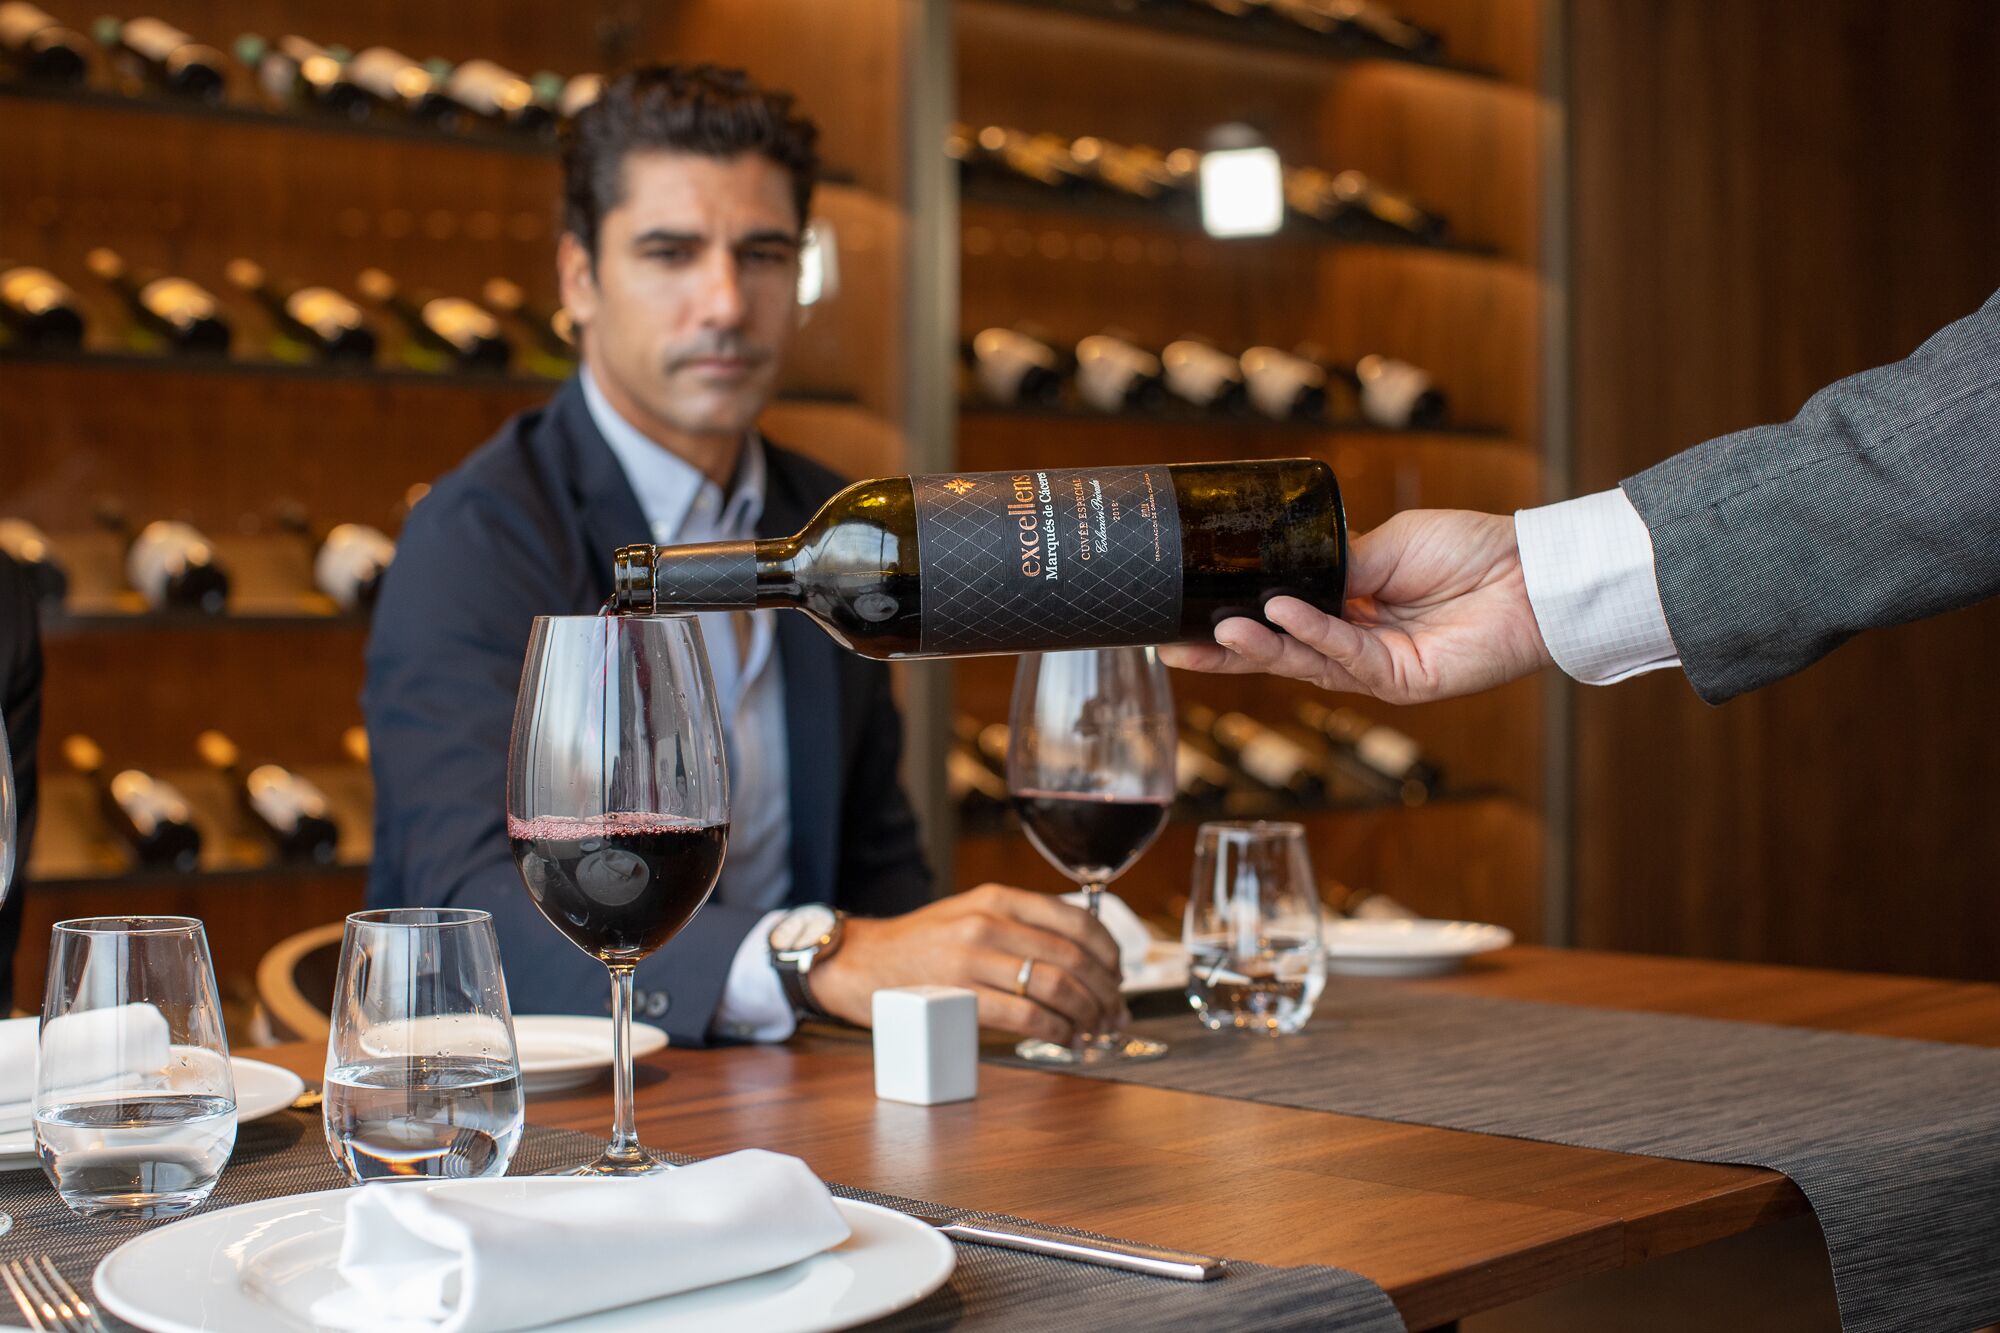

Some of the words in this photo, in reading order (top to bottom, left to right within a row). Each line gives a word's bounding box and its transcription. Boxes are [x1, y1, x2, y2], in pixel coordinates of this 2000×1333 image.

[1037, 472, 1052, 503] Cáceres
[1073, 478, 1087, 519] ESPECIAL
[1089, 479, 1105, 512] Privada
[1008, 474, 1041, 578] excellens
[1043, 504, 1054, 518] de
[1043, 519, 1059, 581] Marqués
[1078, 521, 1090, 561] CUVÉE
[1095, 511, 1108, 553] Colección
